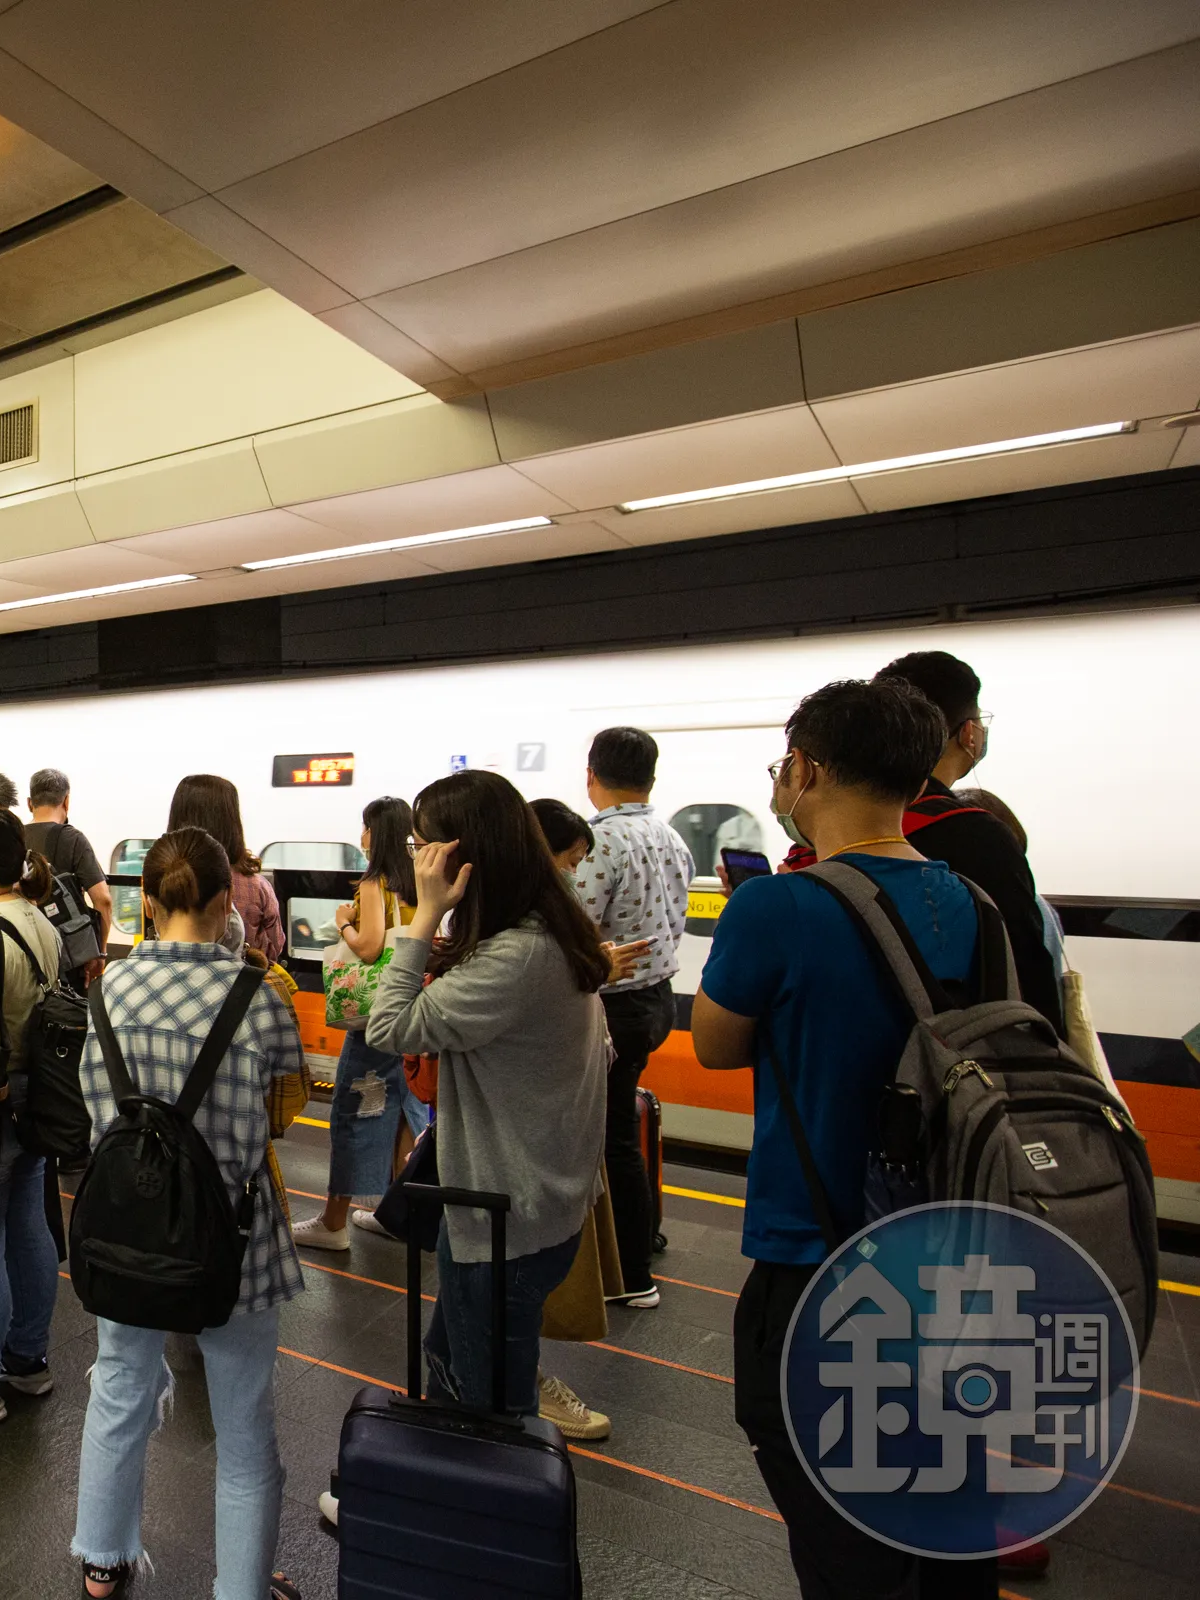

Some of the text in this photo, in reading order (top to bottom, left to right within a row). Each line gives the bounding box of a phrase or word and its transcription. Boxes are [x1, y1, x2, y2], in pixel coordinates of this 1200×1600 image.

[521, 744, 541, 769] 7
[688, 901, 724, 913] No le
[90, 1570, 110, 1581] FILA
